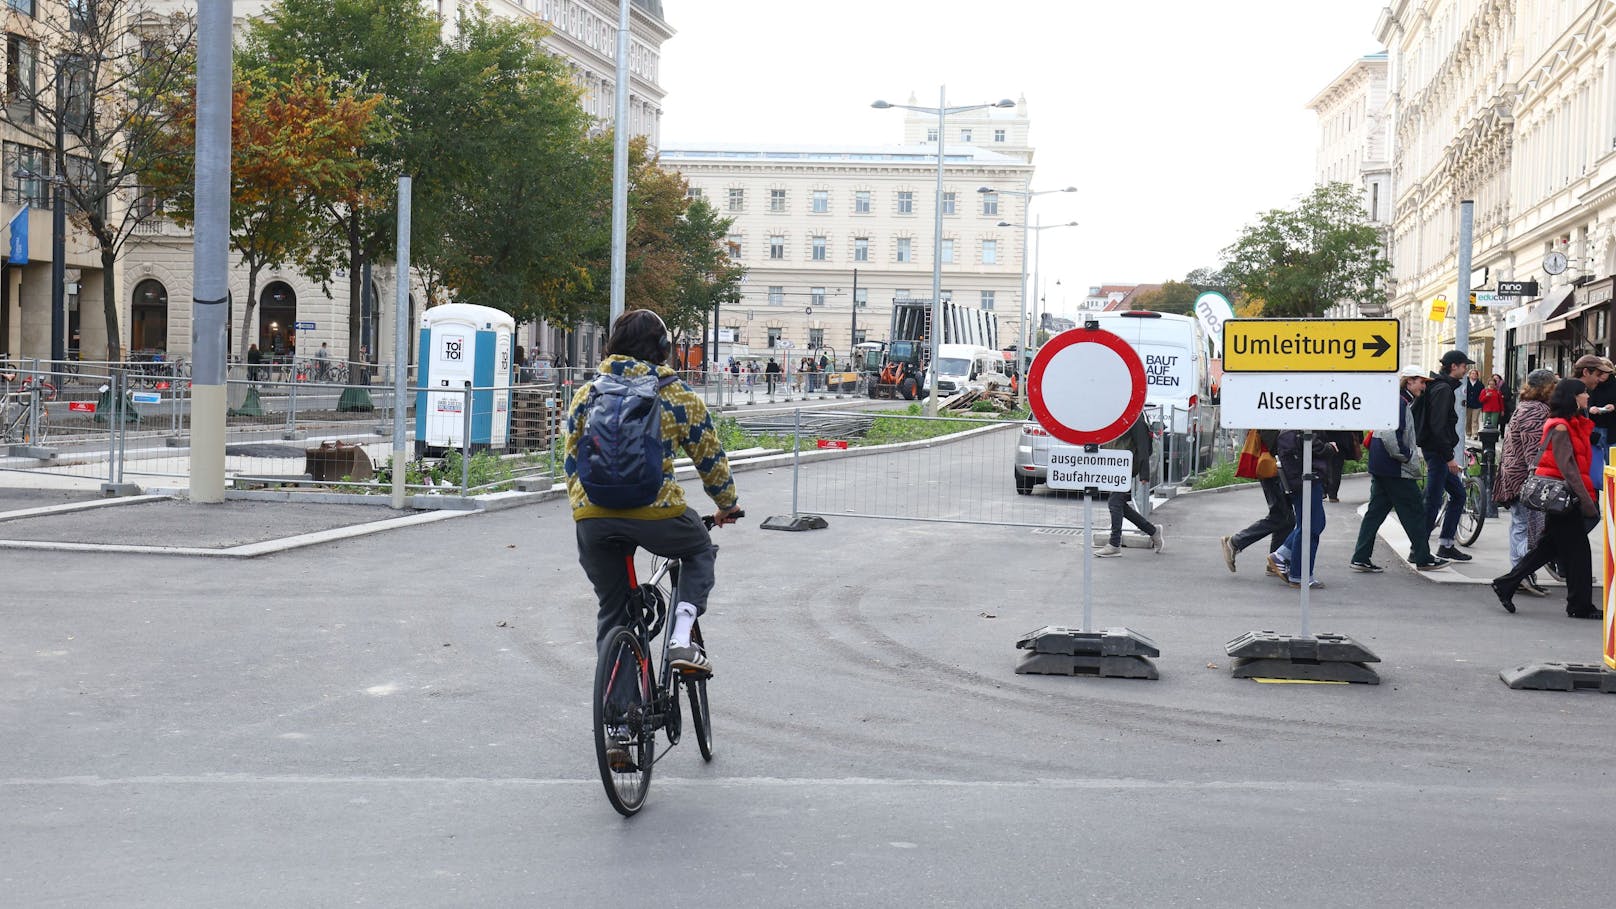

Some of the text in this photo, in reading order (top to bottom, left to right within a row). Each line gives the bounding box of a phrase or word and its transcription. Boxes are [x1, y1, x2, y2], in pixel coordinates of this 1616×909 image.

[1500, 283, 1522, 291] nino
[1198, 302, 1223, 335] com
[1233, 333, 1356, 360] Umleitung
[446, 350, 461, 360] TOI
[1146, 355, 1178, 366] BAUT
[1146, 365, 1171, 375] AUF
[1147, 375, 1180, 387] DEEN
[1257, 391, 1362, 411] Alserstraße
[1051, 455, 1130, 468] ausgenommen
[1052, 470, 1127, 487] Baufahrzeuge
